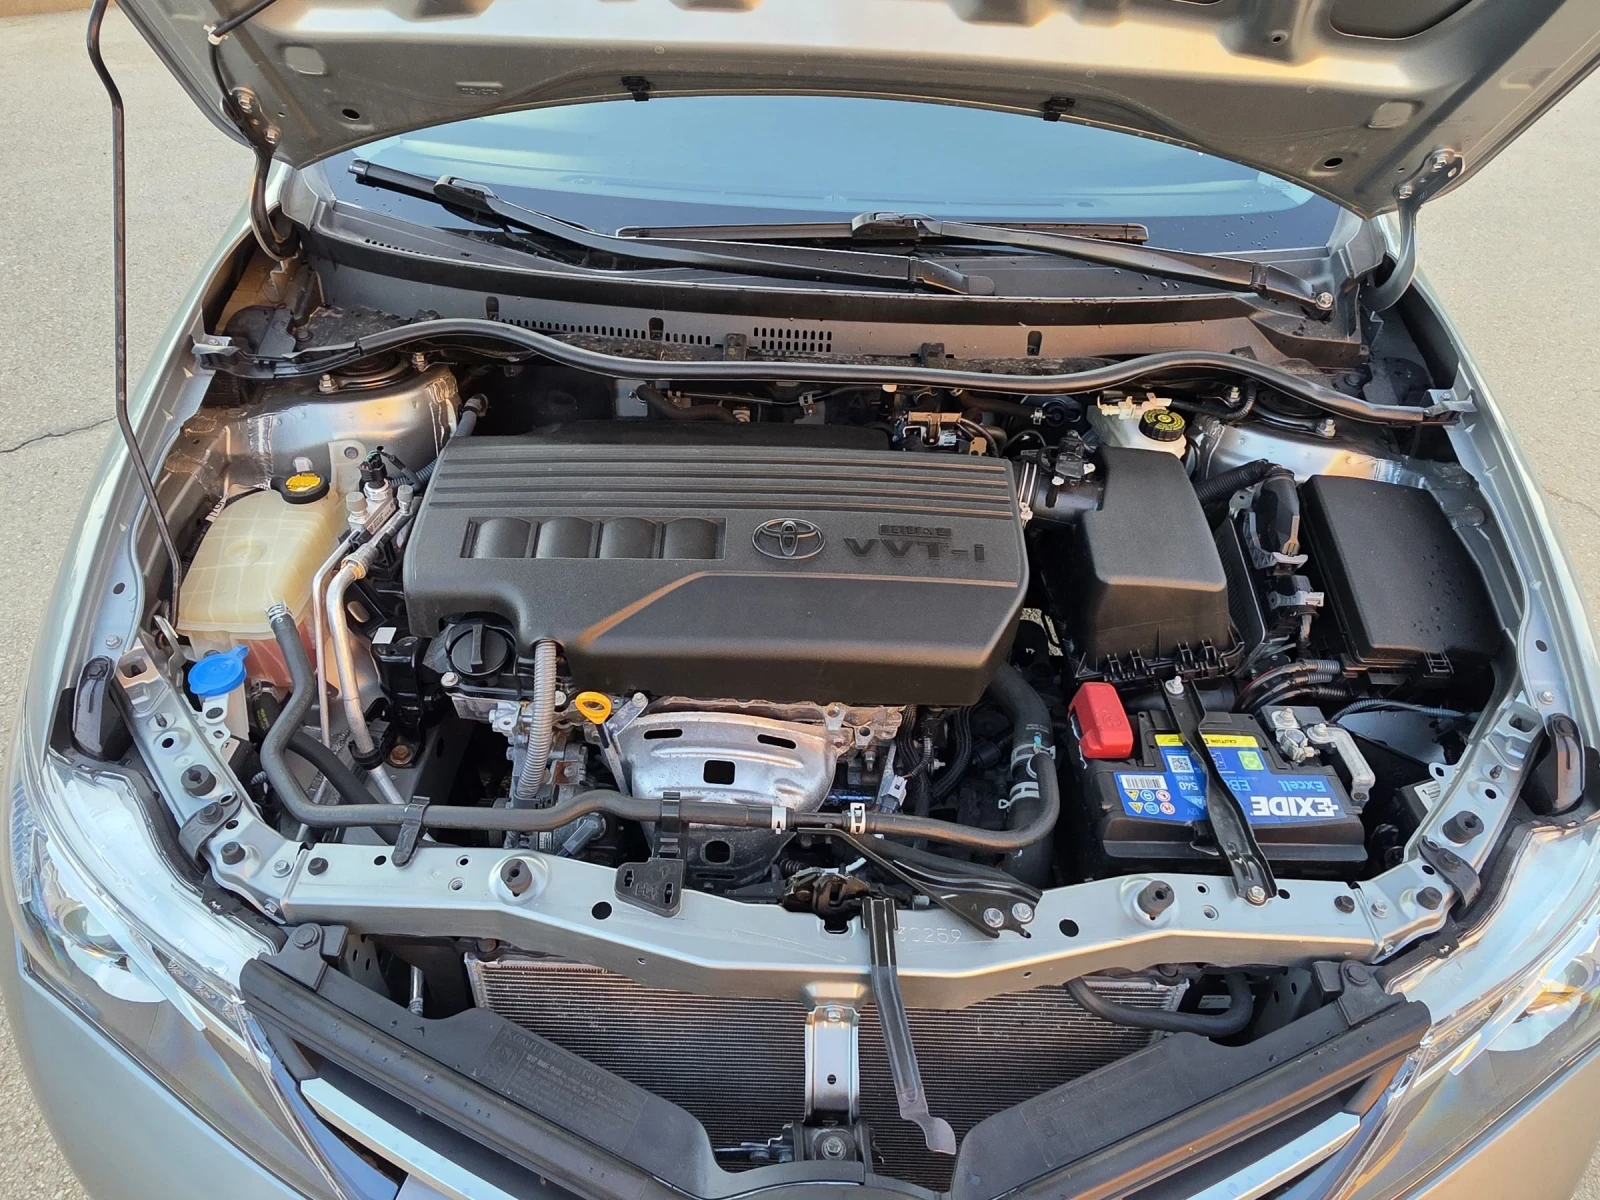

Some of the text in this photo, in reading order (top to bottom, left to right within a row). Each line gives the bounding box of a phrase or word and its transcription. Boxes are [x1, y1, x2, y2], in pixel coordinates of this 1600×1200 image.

[890, 525, 949, 536] DUAL
[1178, 781, 1199, 790] 540
[1277, 780, 1327, 792] Excell
[1249, 795, 1340, 817] EXIDE
[512, 1032, 560, 1062] CAUTION
